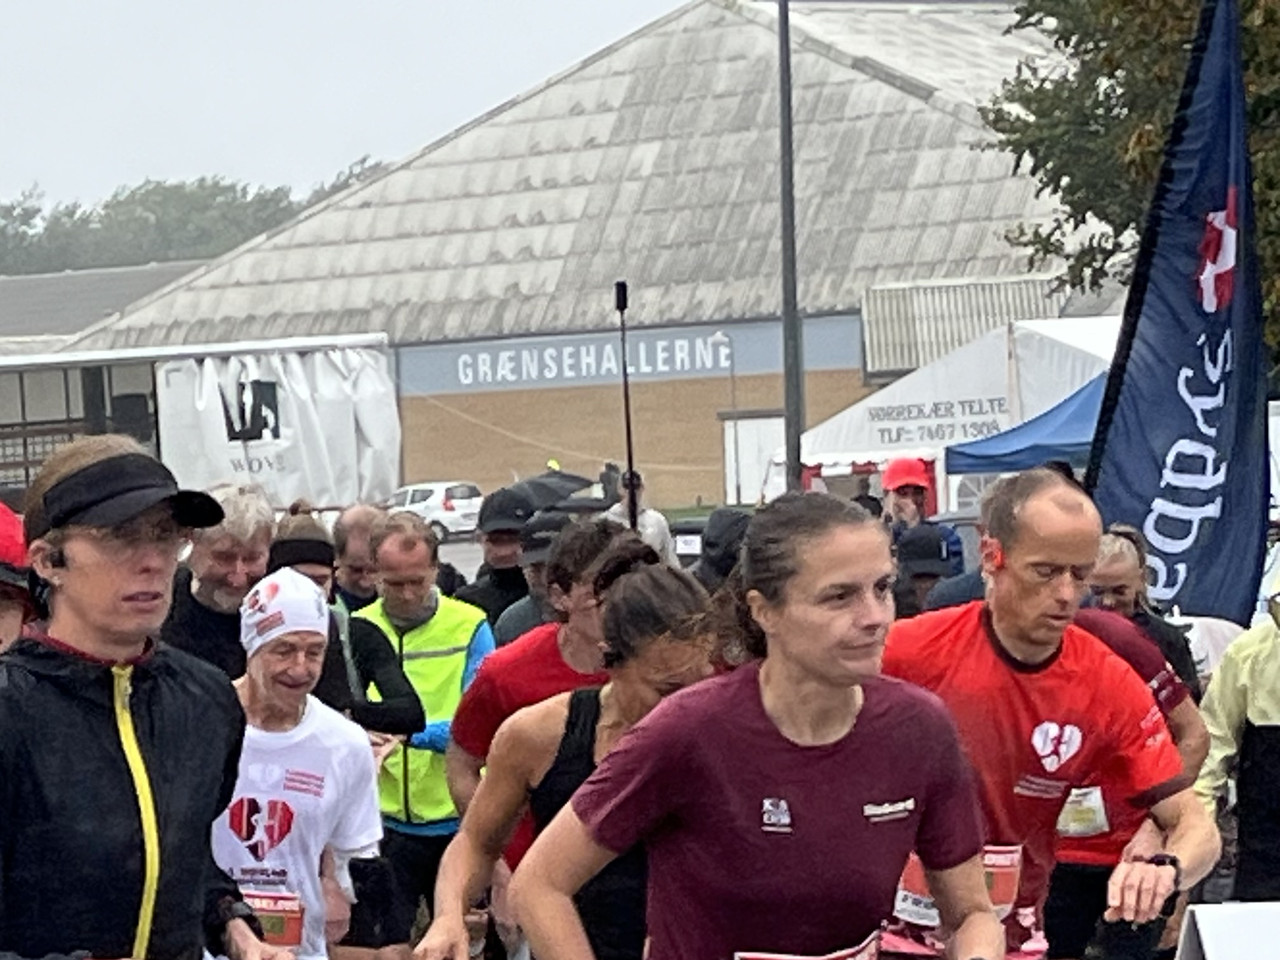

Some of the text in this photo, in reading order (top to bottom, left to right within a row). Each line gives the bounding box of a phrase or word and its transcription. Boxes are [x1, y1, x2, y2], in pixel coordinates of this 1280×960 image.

[458, 337, 731, 385] GRÆNSEHALLERNE
[958, 397, 1008, 416] TELTE
[1143, 328, 1232, 600] Sydba
